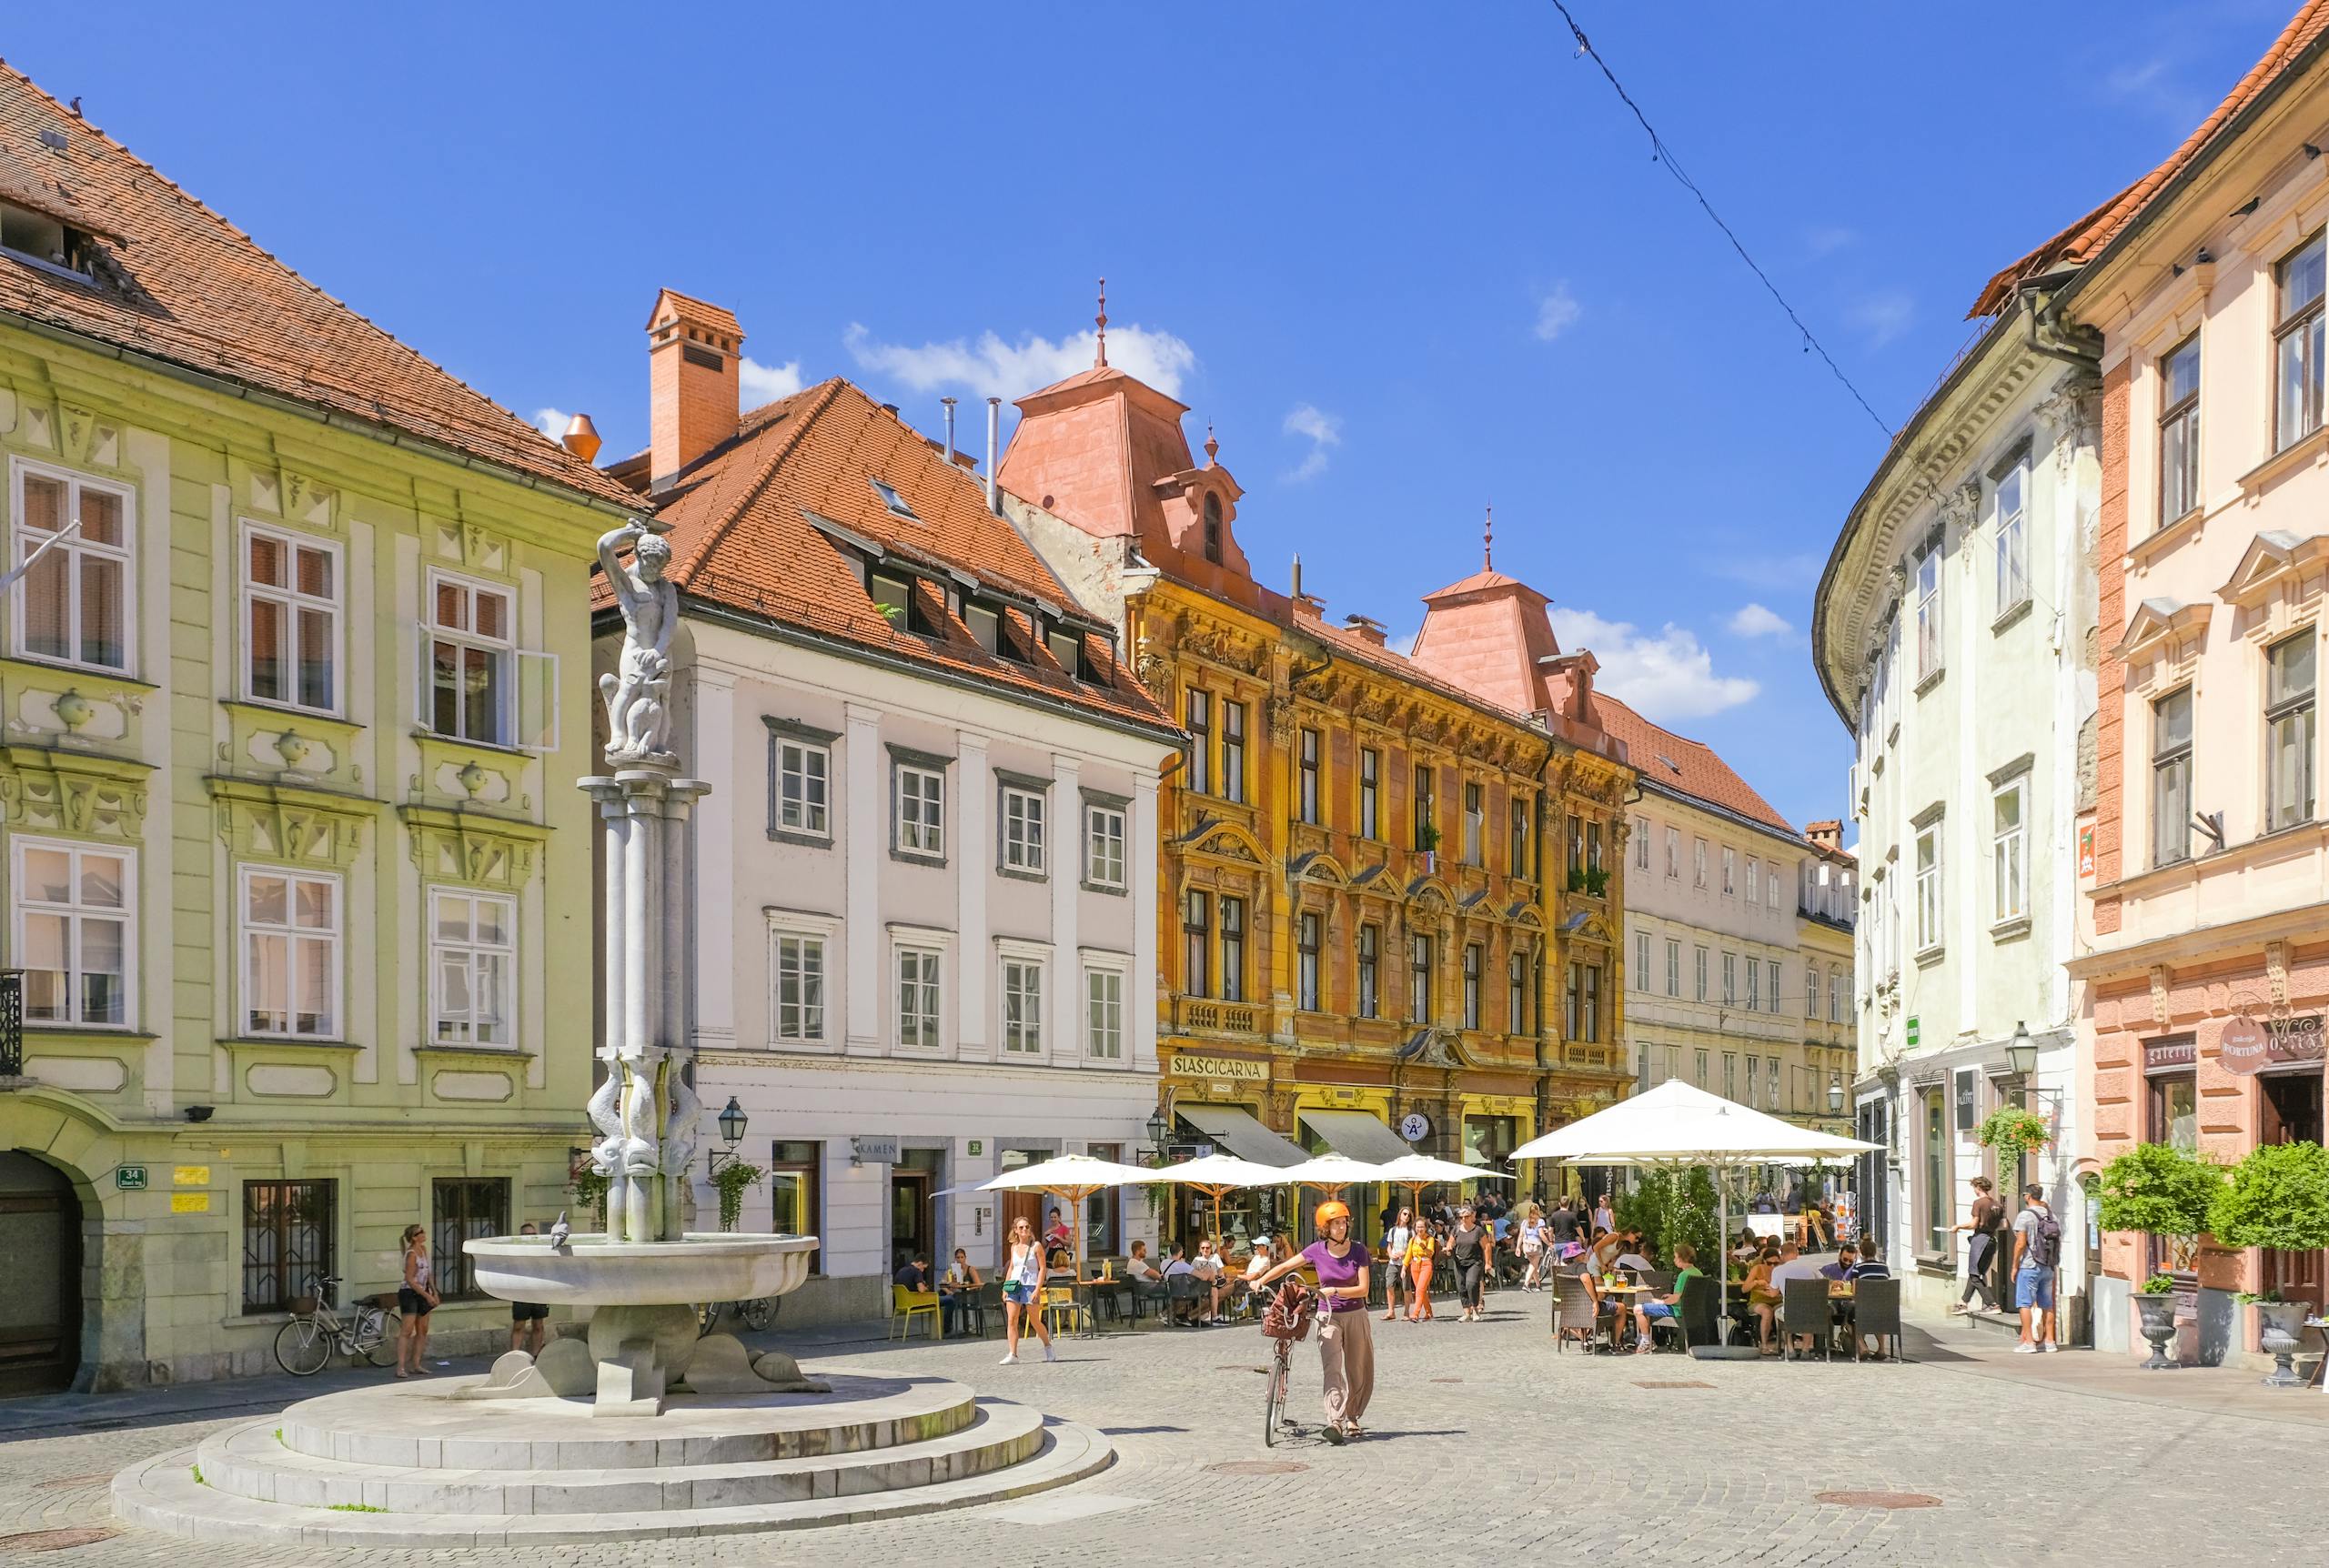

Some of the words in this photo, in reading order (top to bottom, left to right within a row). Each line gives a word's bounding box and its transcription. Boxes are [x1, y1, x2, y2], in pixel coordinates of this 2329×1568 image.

[2223, 1042, 2264, 1057] FORTUNA
[860, 1143, 896, 1154] KAMEN
[126, 1170, 138, 1179] 34
